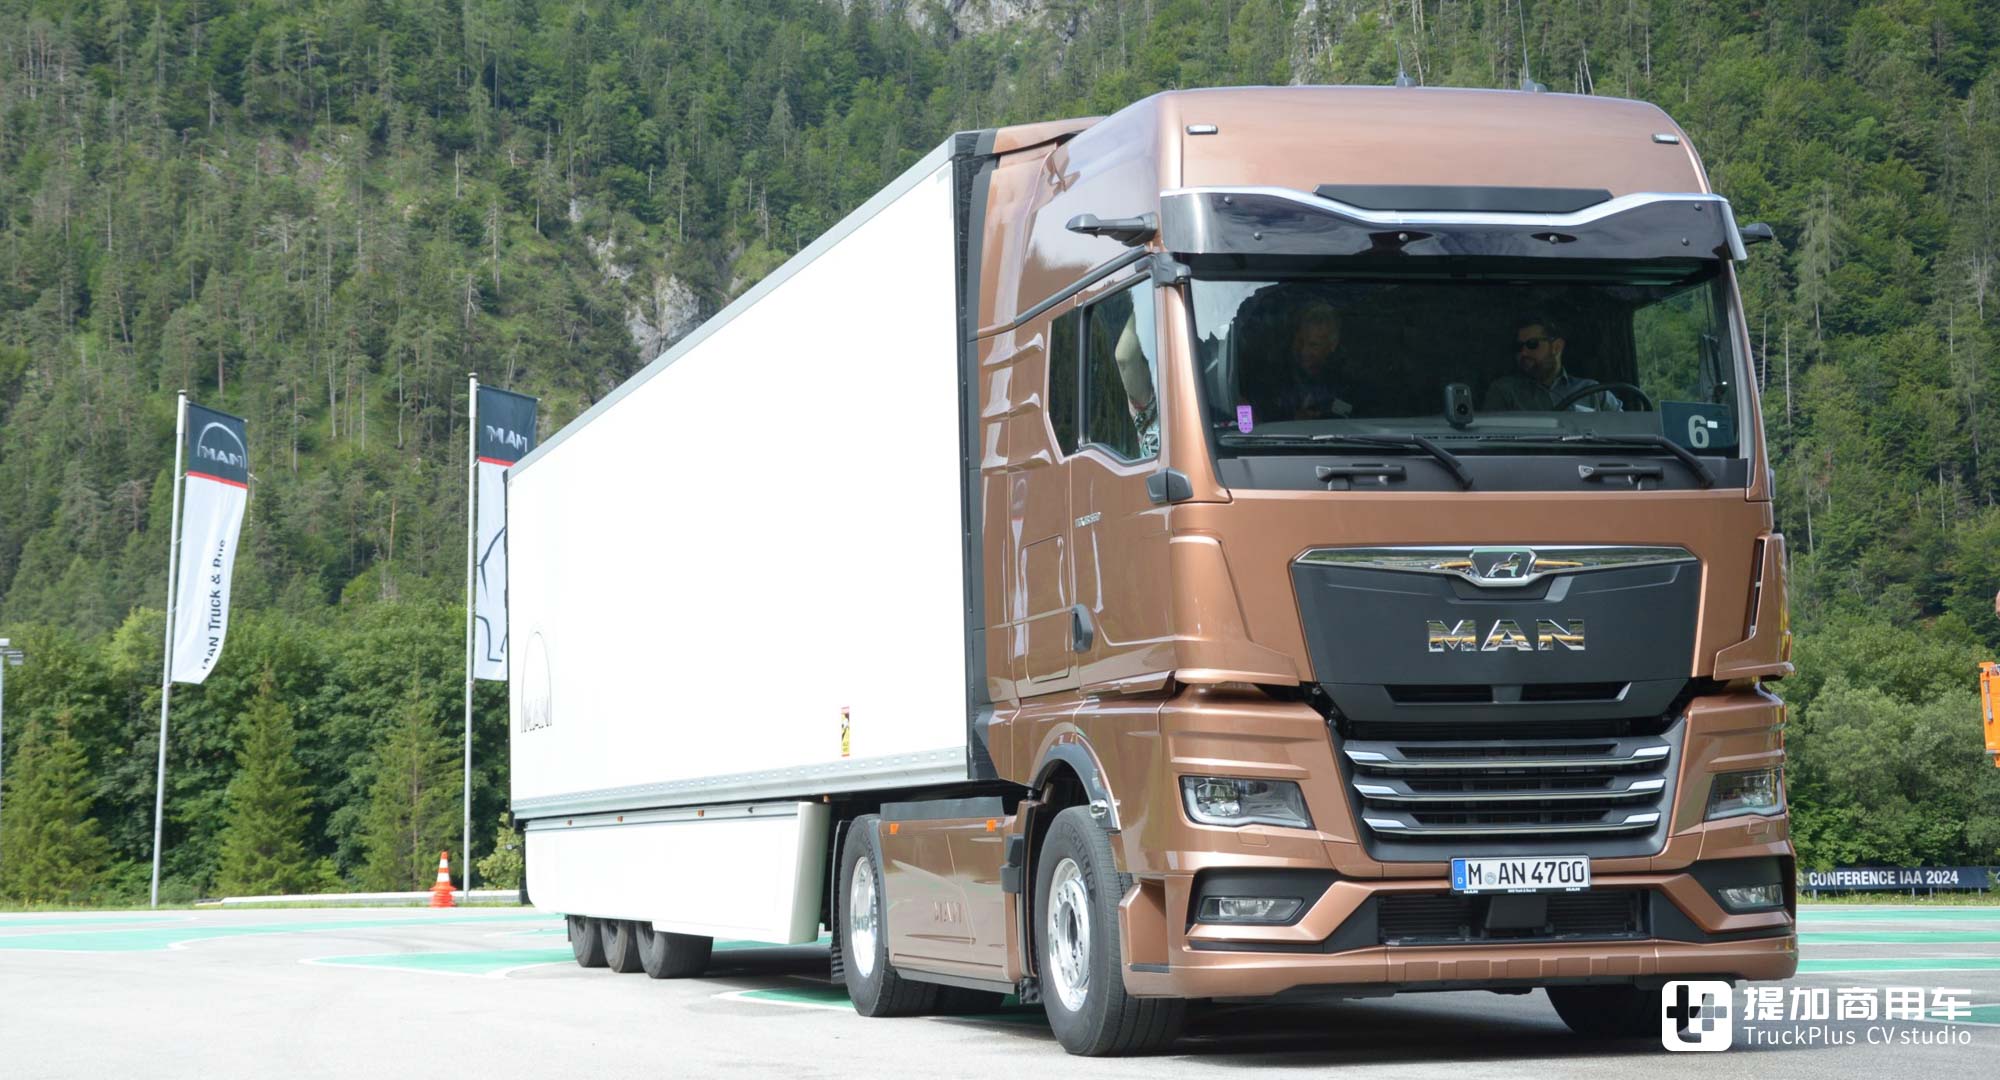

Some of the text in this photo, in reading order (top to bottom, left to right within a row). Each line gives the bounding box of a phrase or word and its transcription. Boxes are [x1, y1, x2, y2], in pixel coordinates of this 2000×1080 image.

[486, 424, 528, 453] MAN
[1687, 414, 1710, 449] 6
[200, 445, 243, 468] MAN
[210, 573, 221, 585] &
[207, 589, 222, 632] Truck
[1427, 618, 1586, 653] MAN
[1467, 861, 1585, 885] M AN 4700
[1809, 871, 1896, 887] CONFERENCE
[1900, 870, 1924, 885] IAA
[1926, 870, 1959, 885] 2024
